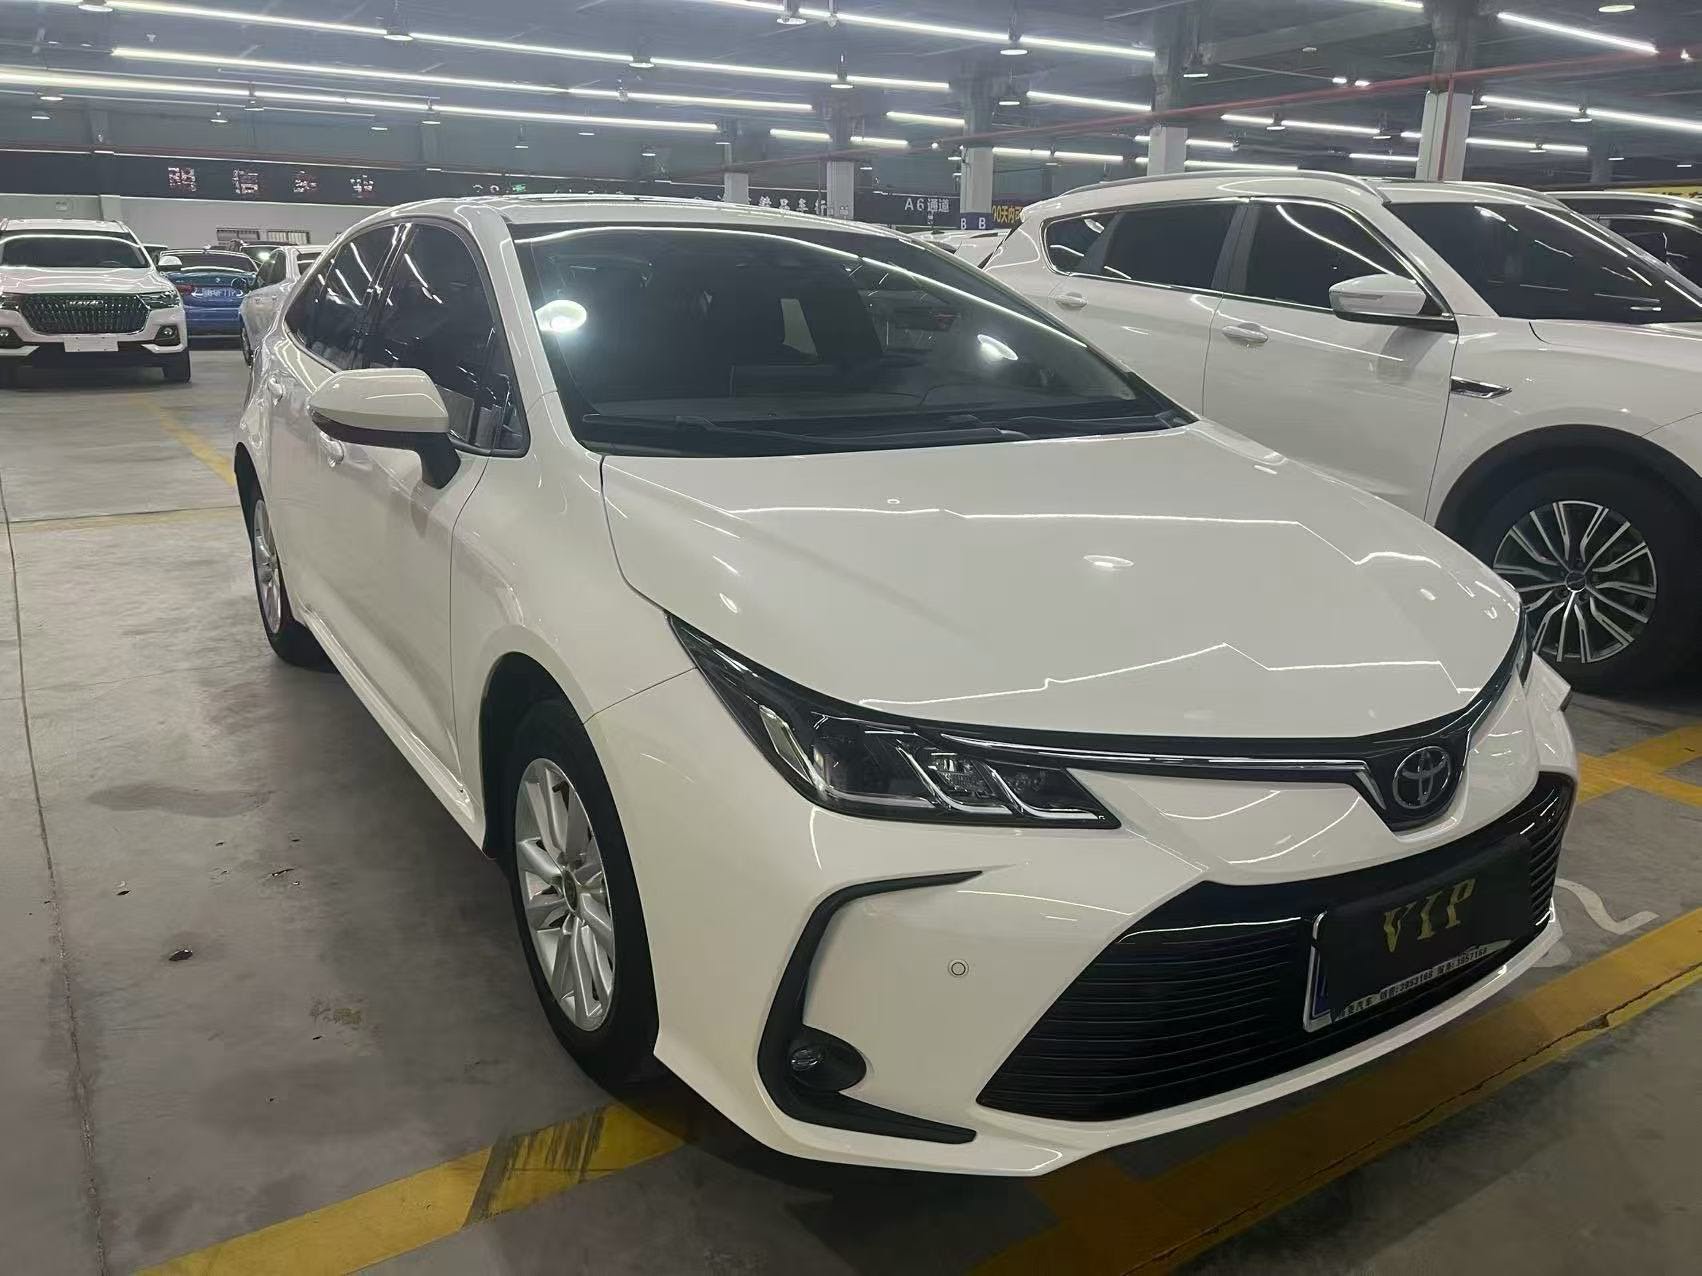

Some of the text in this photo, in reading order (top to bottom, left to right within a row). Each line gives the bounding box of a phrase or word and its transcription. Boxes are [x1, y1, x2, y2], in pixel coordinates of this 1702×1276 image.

[961, 218, 967, 229] B
[979, 217, 986, 229] B
[1384, 879, 1475, 952] VIP
